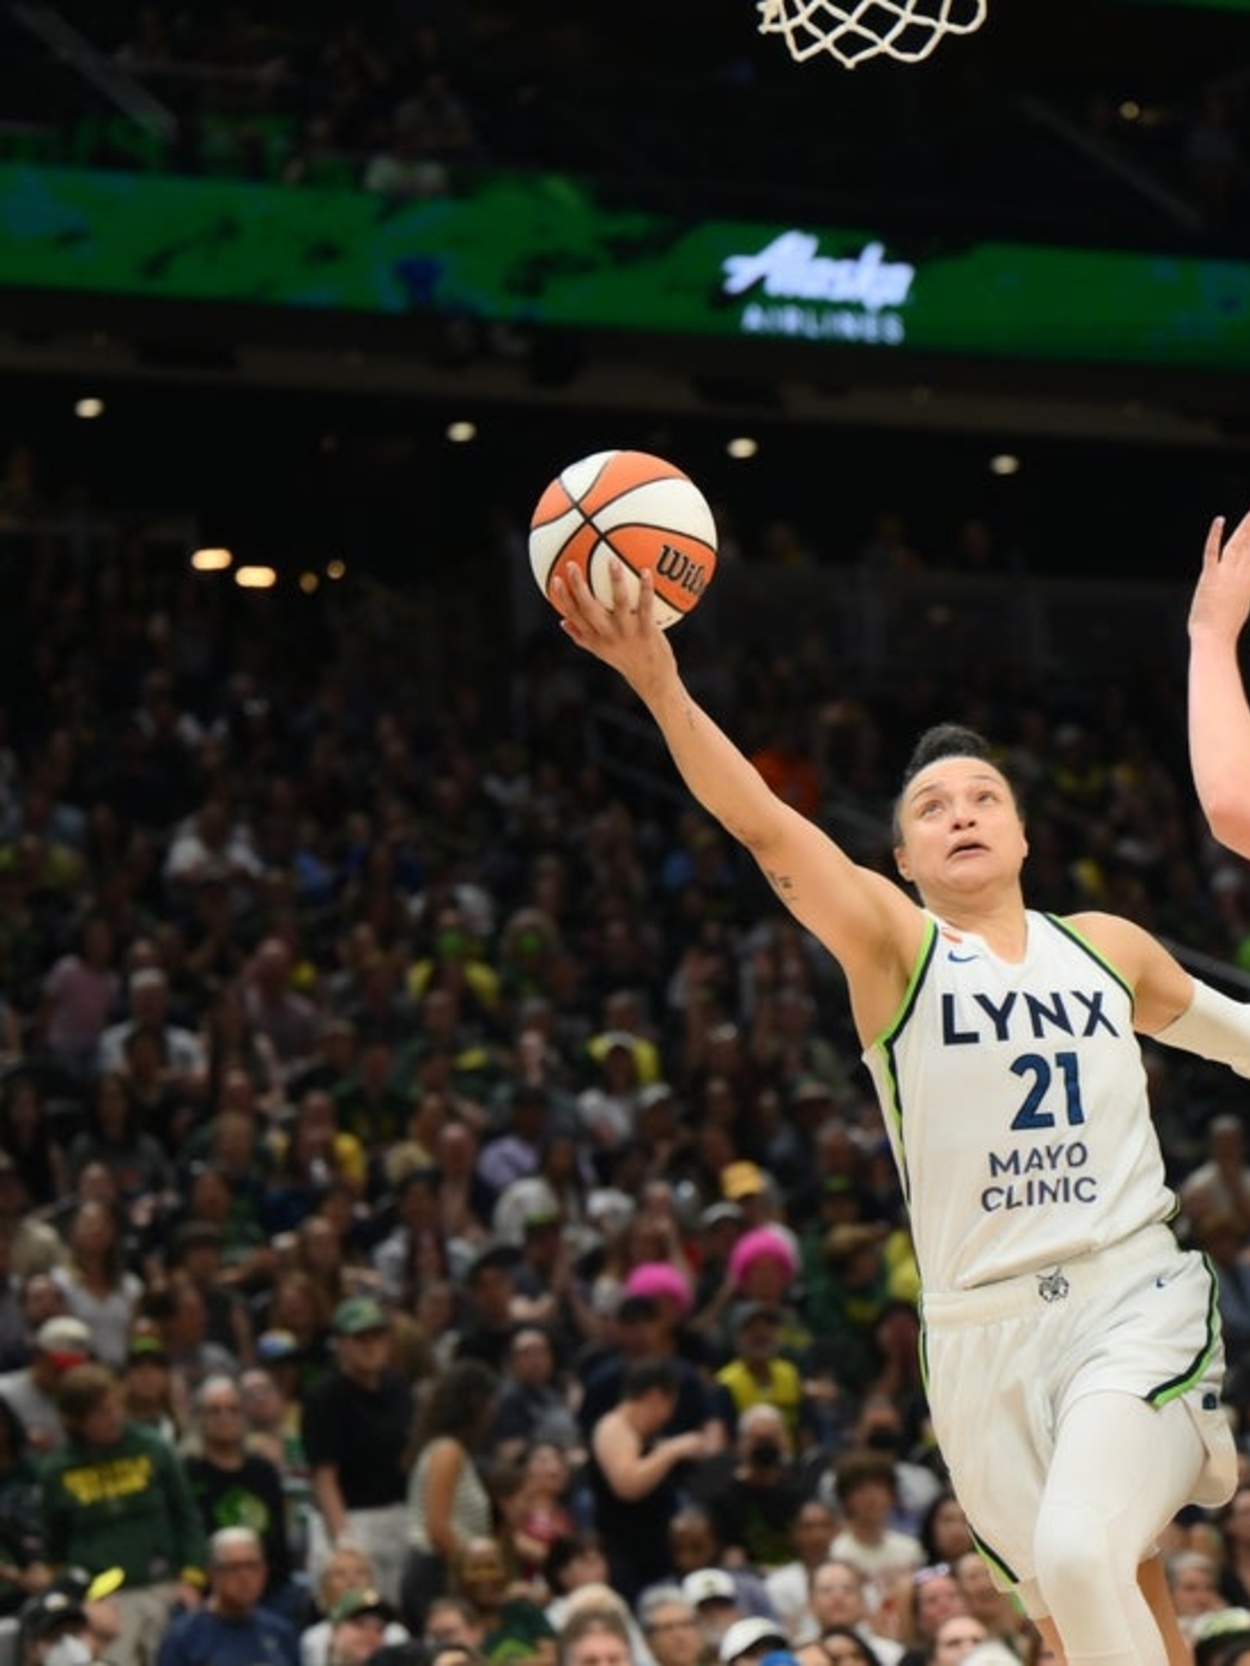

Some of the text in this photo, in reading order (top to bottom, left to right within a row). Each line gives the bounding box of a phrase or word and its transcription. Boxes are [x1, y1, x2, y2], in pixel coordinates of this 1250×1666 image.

[721, 231, 914, 312] Alaska
[742, 304, 904, 345] AIRLINES
[941, 990, 1119, 1045] LYNX
[1009, 1052, 1085, 1130] 21
[988, 1142, 1088, 1178] MAYO
[981, 1177, 1097, 1213] CLINIC
